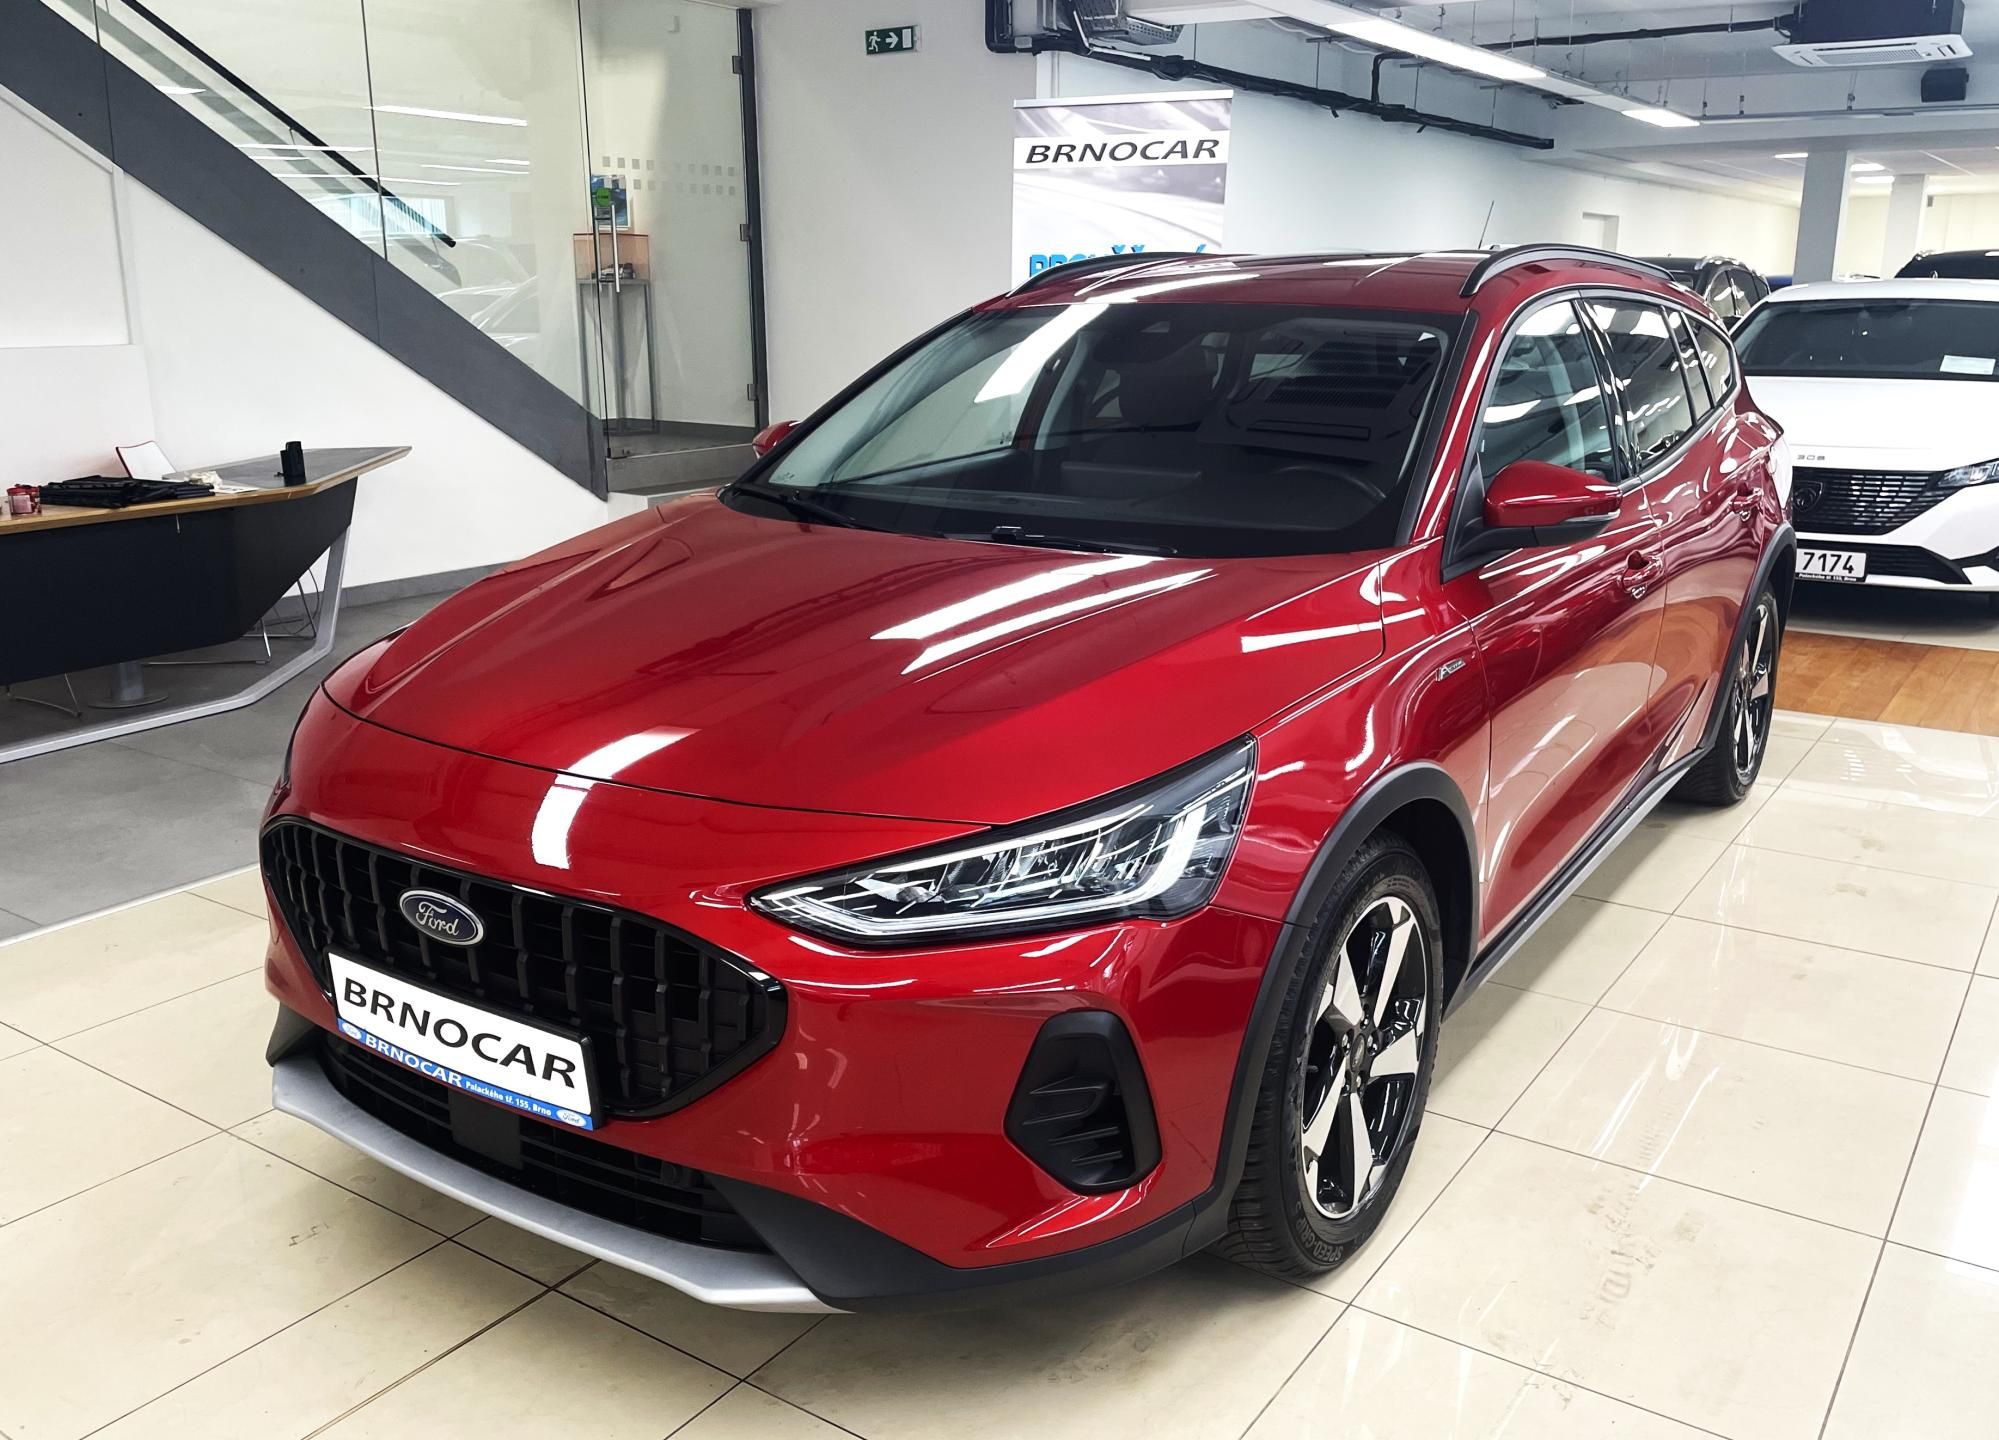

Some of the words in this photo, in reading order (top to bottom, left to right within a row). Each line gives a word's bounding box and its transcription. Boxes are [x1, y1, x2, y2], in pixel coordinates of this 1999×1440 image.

[1025, 139, 1220, 164] BRNOCAR
[1802, 552, 1855, 574] 7174
[415, 901, 459, 936] Ford
[343, 976, 576, 1089] BRNOCAR
[364, 1033, 463, 1088] BRNOCAR
[465, 1080, 504, 1101] Palackého
[515, 1097, 532, 1111] 155,
[532, 1102, 552, 1117] Brno
